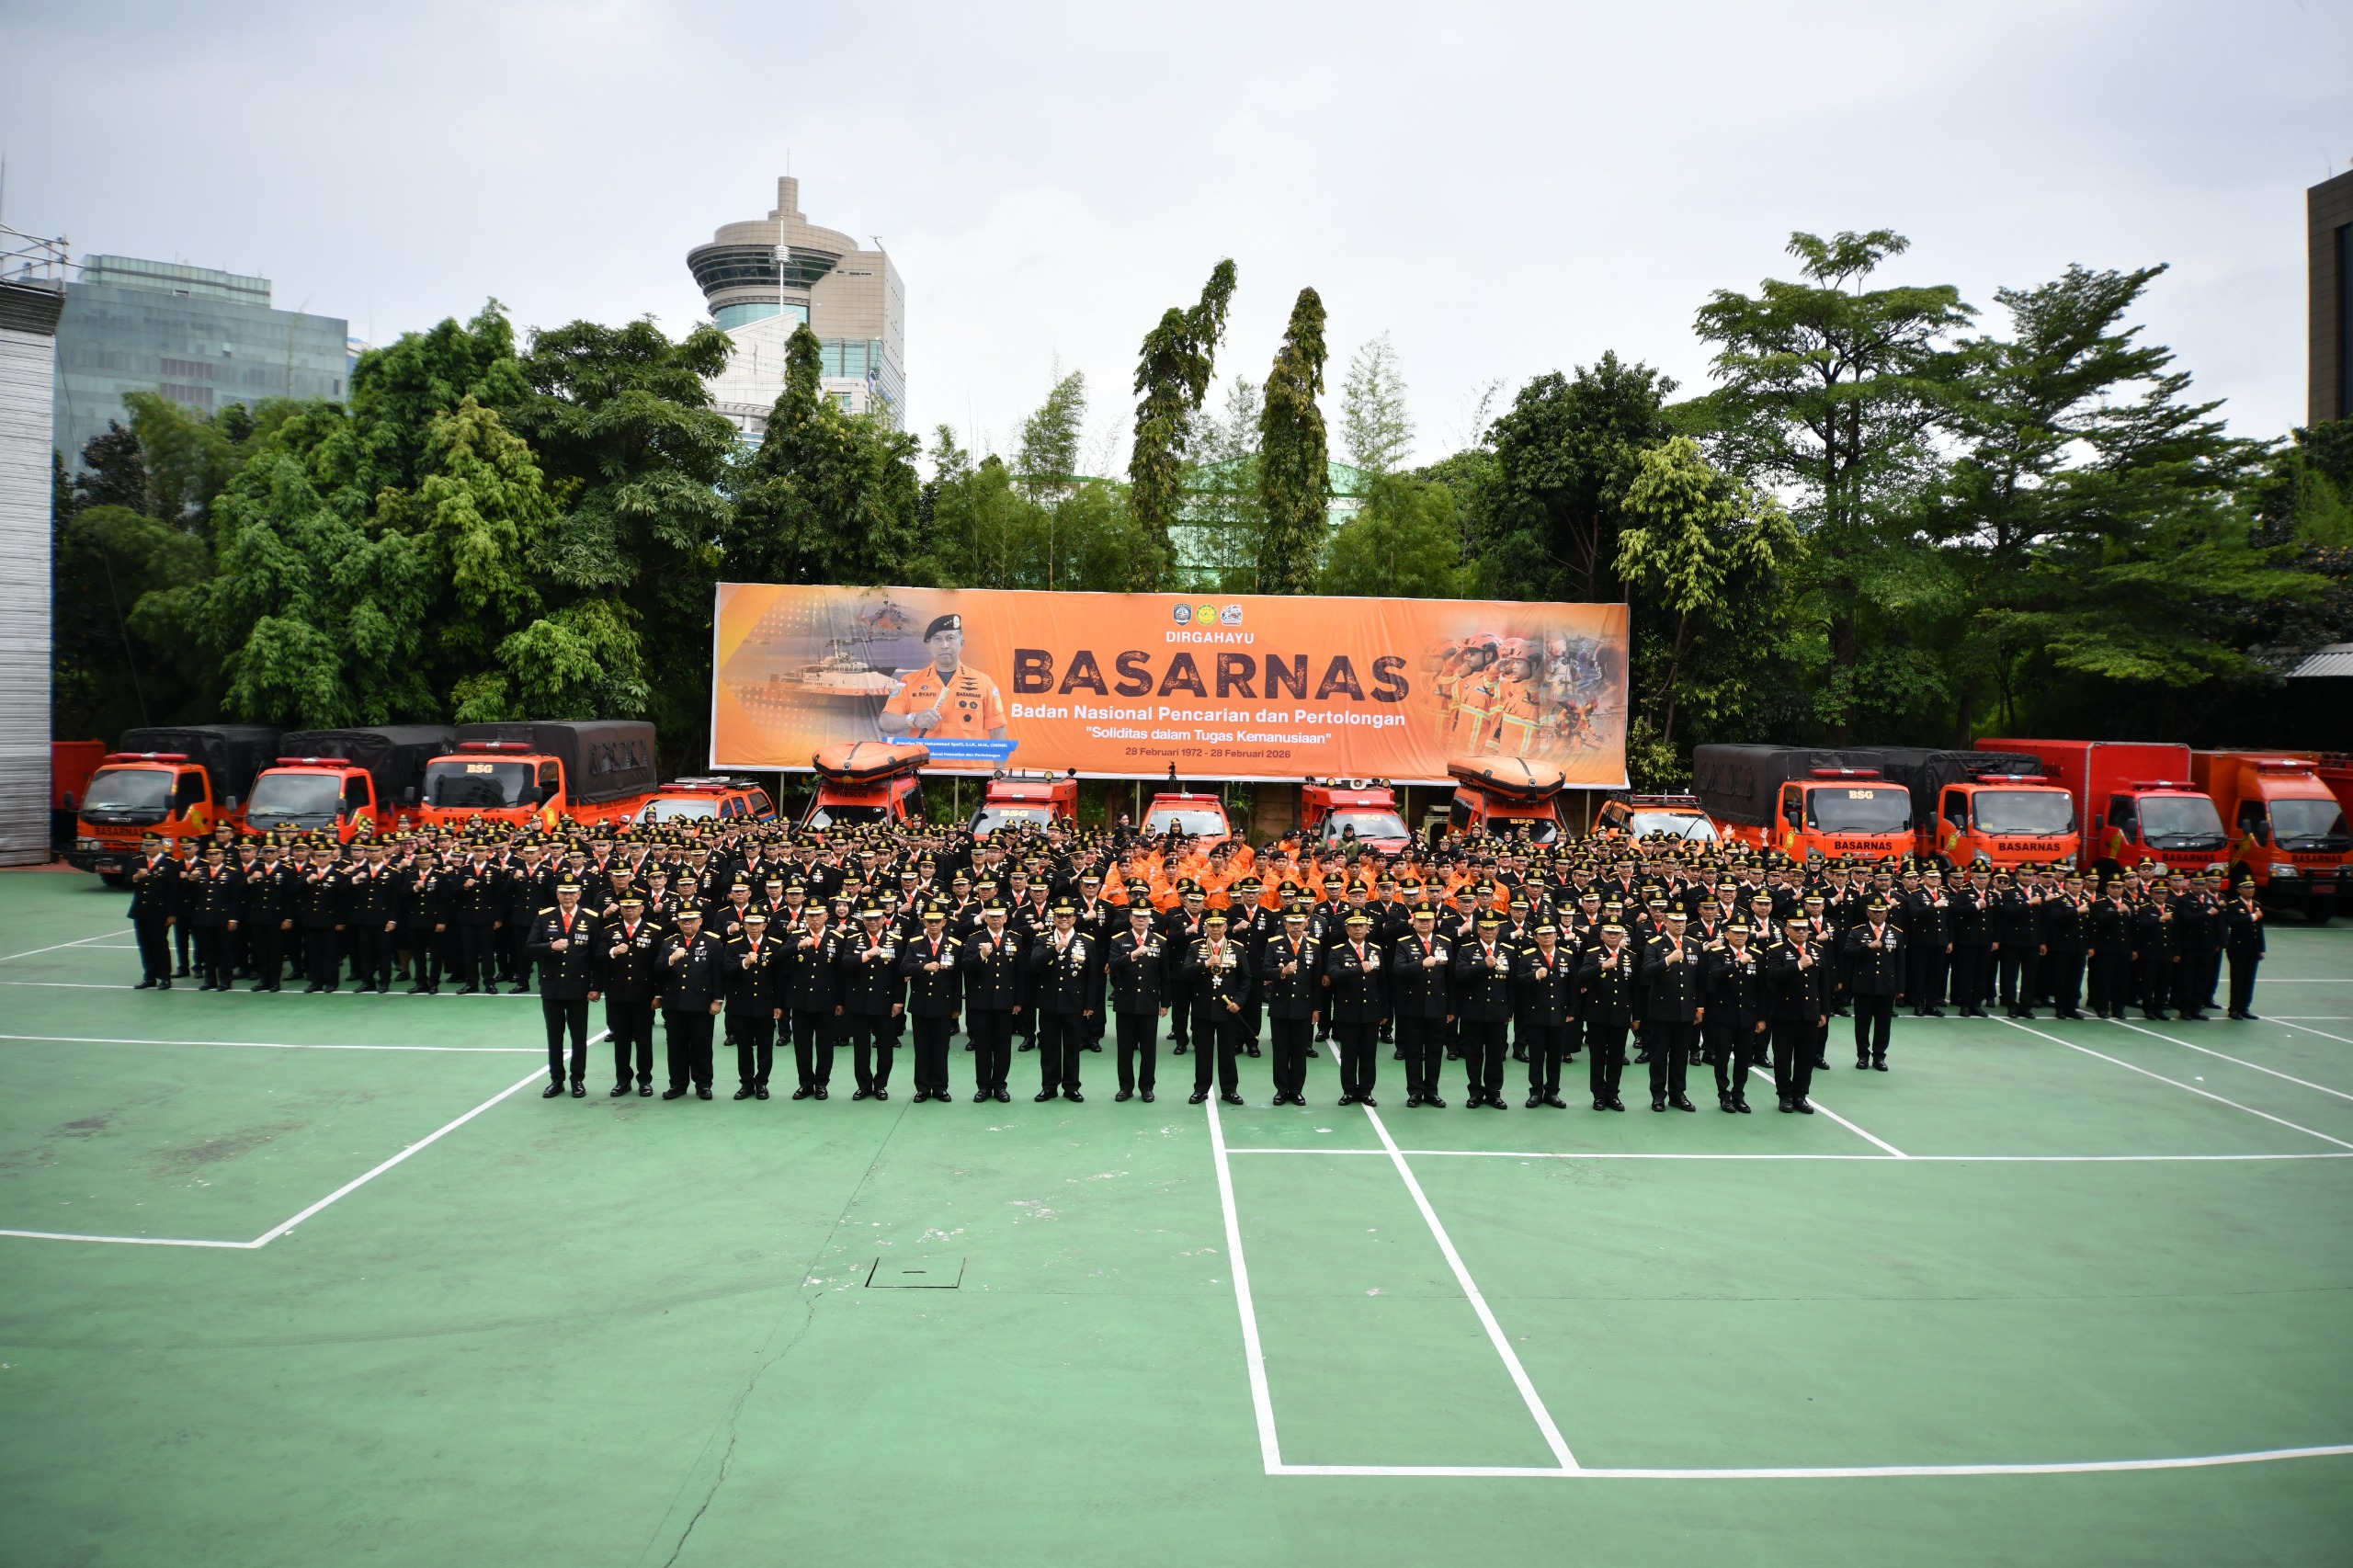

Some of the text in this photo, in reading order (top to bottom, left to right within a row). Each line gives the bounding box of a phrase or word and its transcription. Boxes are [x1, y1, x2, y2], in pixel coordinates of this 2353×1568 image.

[1165, 631, 1255, 644] DIRGAHAYU
[1013, 648, 1410, 703] BASARNAS
[1011, 703, 1405, 729] Badan Nasional Pencarian dan Pertolongan
[1086, 726, 1332, 744] "Soliditas dalam Tugas Kemanusiaan"
[1125, 746, 1138, 756] 28
[1141, 747, 1179, 756] Februari
[1181, 748, 1202, 757] 1972
[1211, 749, 1223, 757] 28
[1225, 749, 1264, 758] Februari
[1267, 750, 1290, 758] 2026
[466, 764, 494, 773] BSG
[1848, 790, 1873, 800] BSG
[95, 827, 145, 836] BASARNAS
[1835, 841, 1893, 851] BASARNAS
[1998, 842, 2061, 852] BASARNAS
[2162, 853, 2216, 863] BASARNAS
[2292, 854, 2343, 864] BASARNAS
